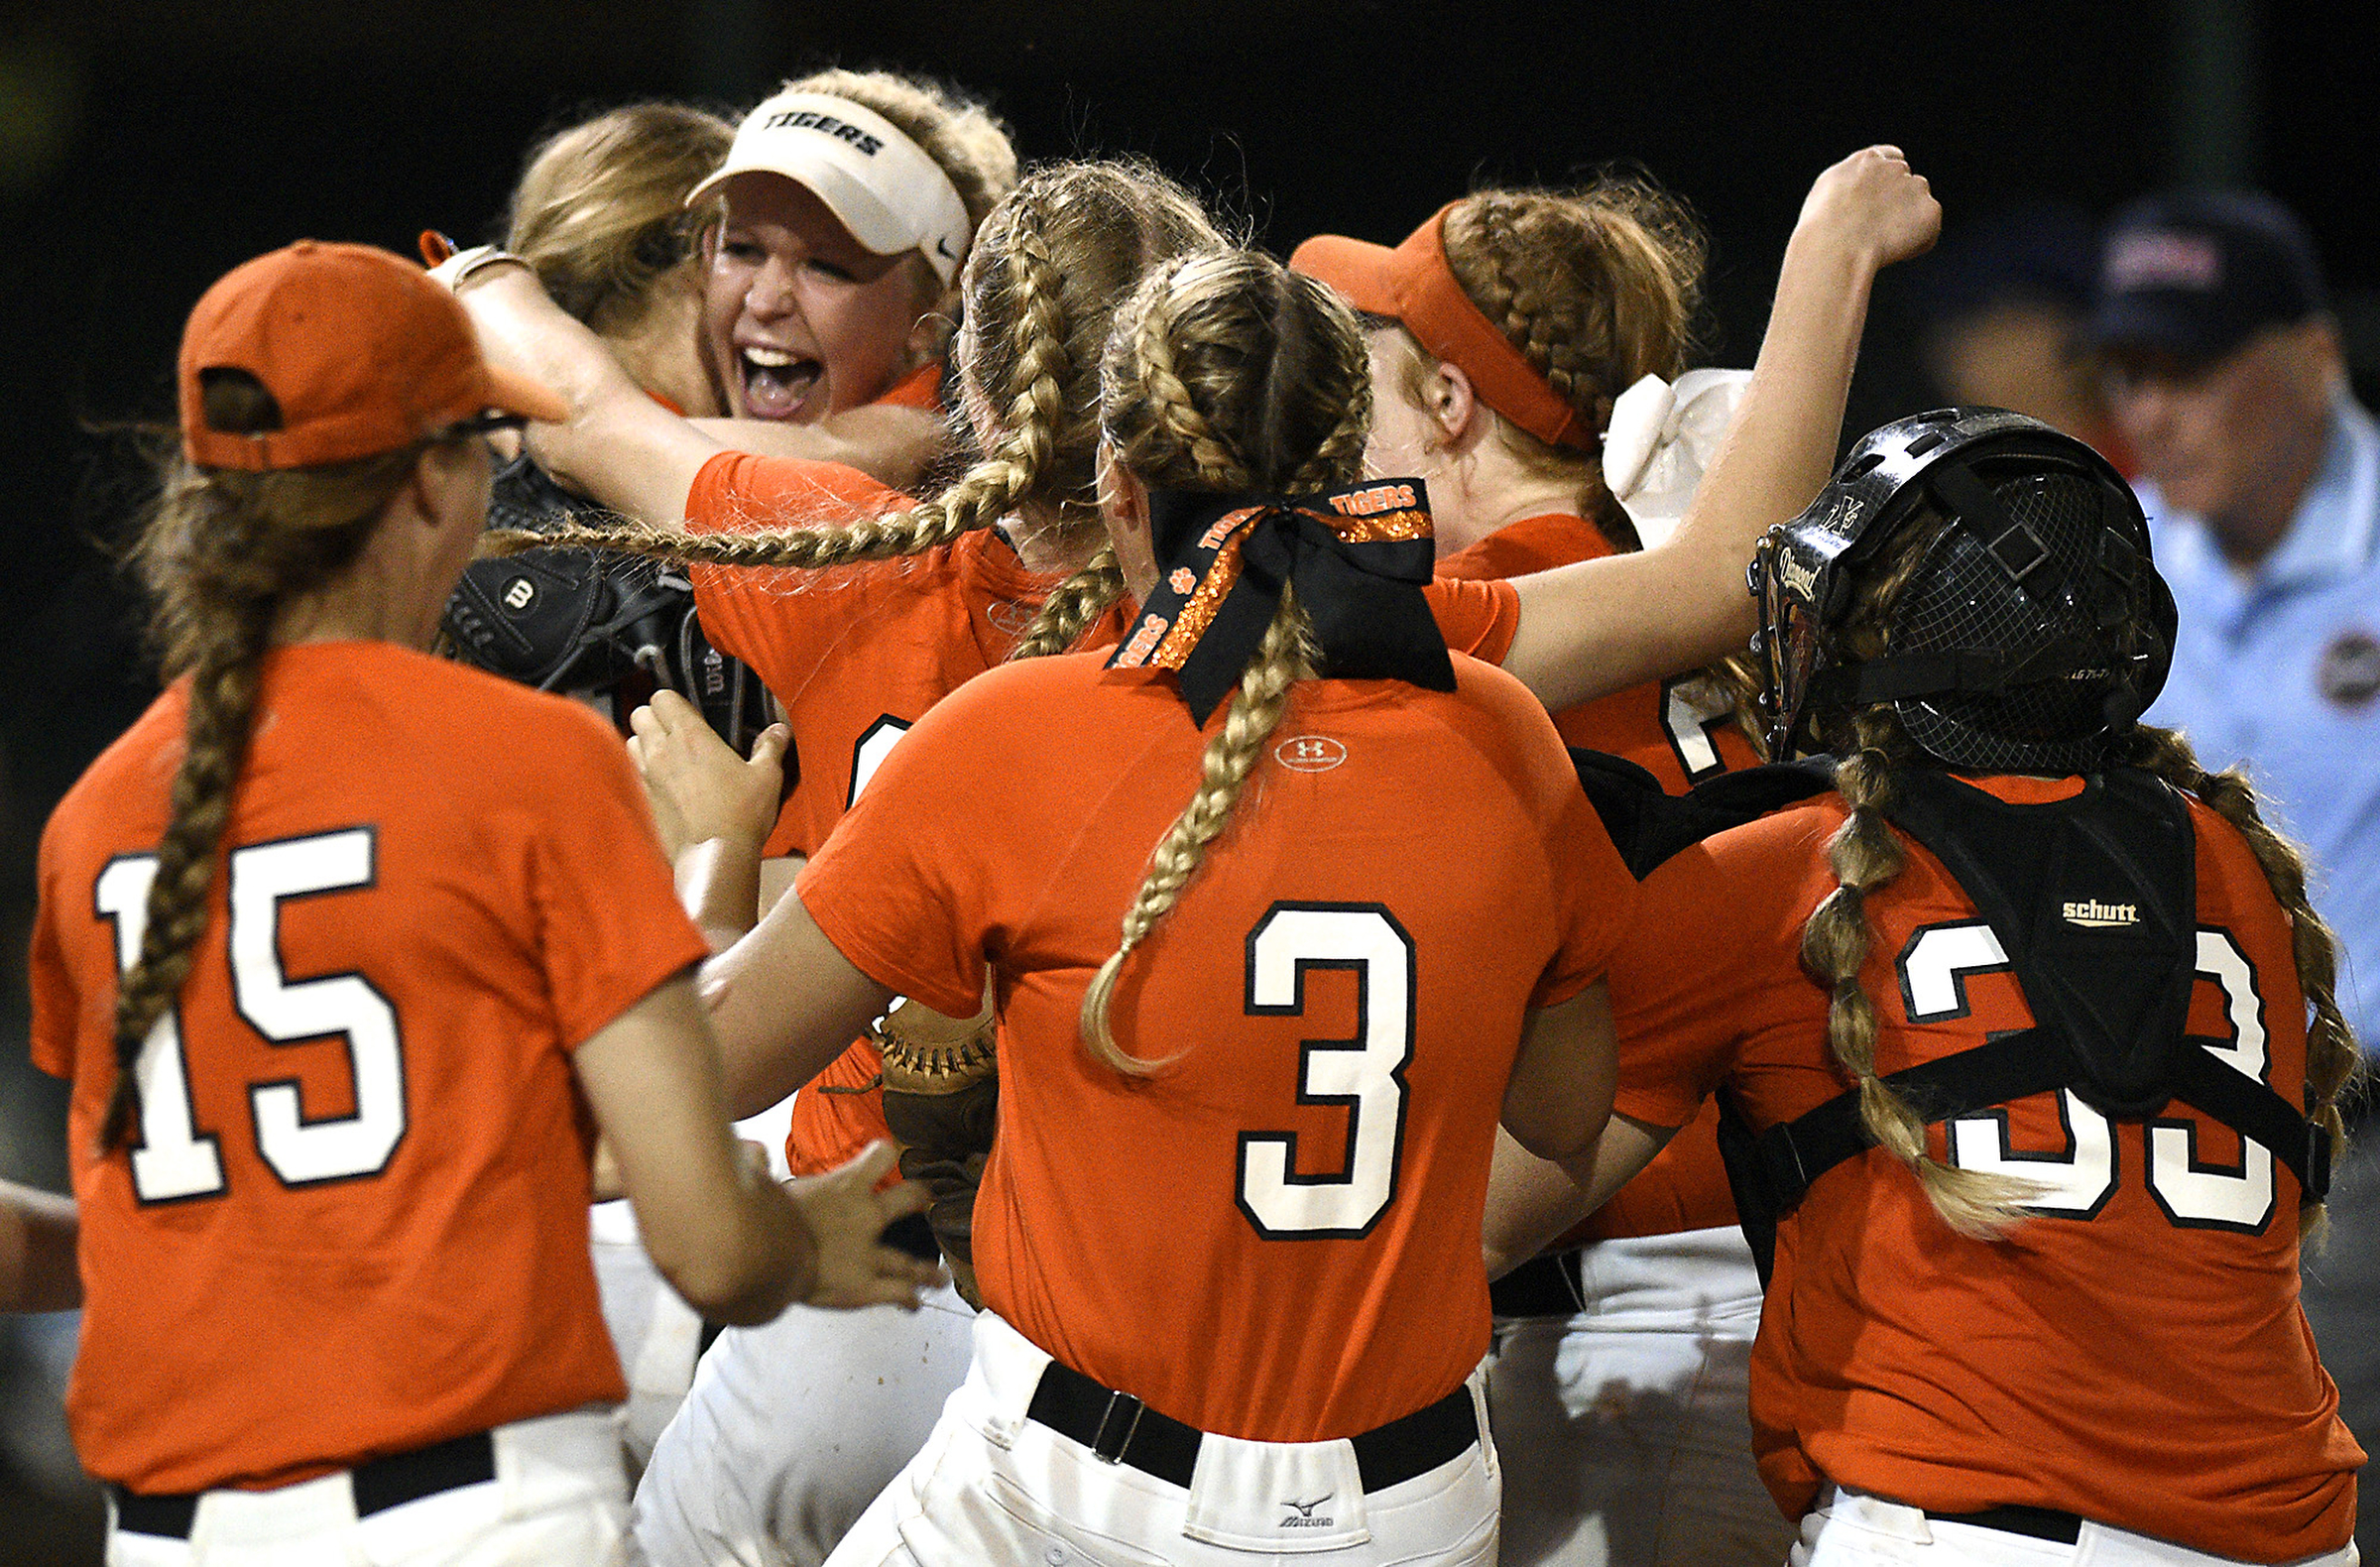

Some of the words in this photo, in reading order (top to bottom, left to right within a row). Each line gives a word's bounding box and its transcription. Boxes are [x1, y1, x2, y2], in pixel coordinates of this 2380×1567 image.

[763, 110, 885, 158] TIGERS
[1329, 484, 1417, 516] TIGERS
[1197, 505, 1265, 549] TIGE
[2063, 899, 2138, 922] schutt
[95, 825, 408, 1208] 15
[1235, 901, 1416, 1240] 3
[1279, 1515, 1335, 1527] MIZUNO
